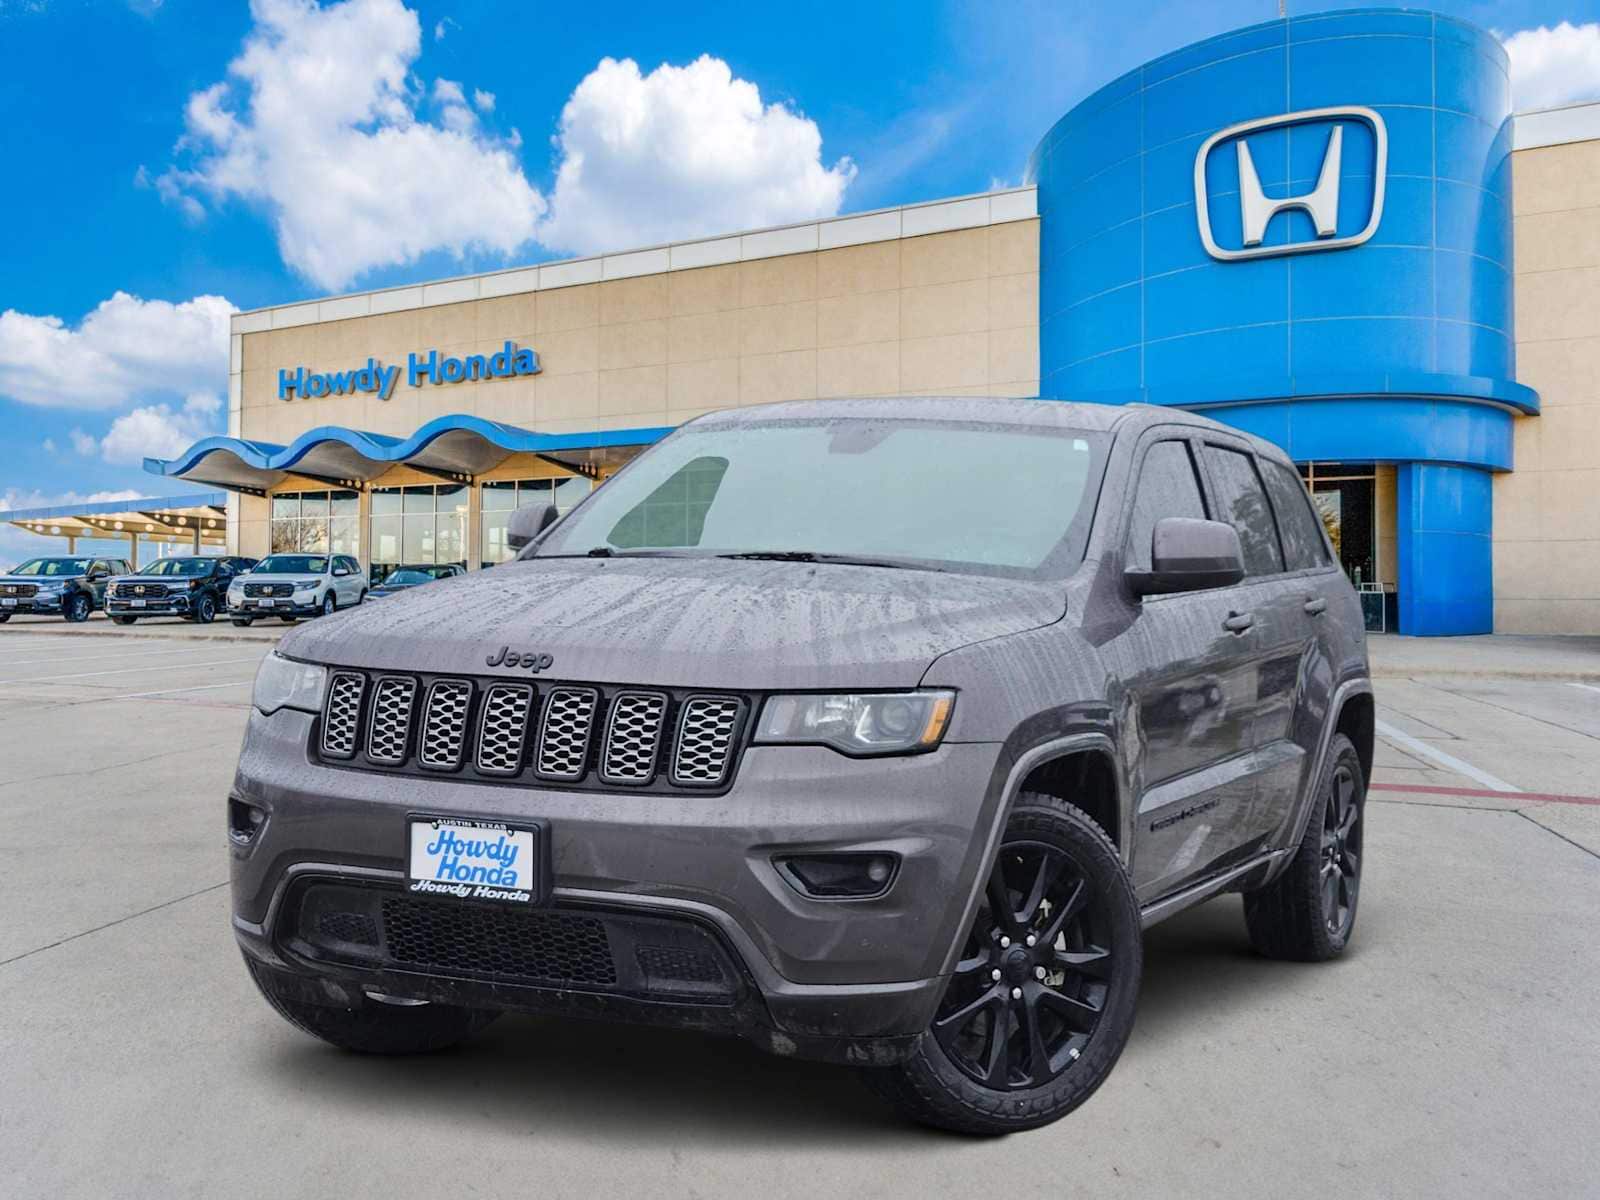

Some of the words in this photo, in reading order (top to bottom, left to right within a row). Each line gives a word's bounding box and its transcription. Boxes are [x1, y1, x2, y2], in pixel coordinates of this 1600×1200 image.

[277, 358, 400, 401] Howdy
[407, 340, 542, 388] Honda
[486, 646, 554, 674] Jeep
[427, 830, 519, 868] Howdy
[436, 854, 518, 887] Honda
[410, 879, 472, 898] Howdy
[473, 885, 531, 902] Honda
